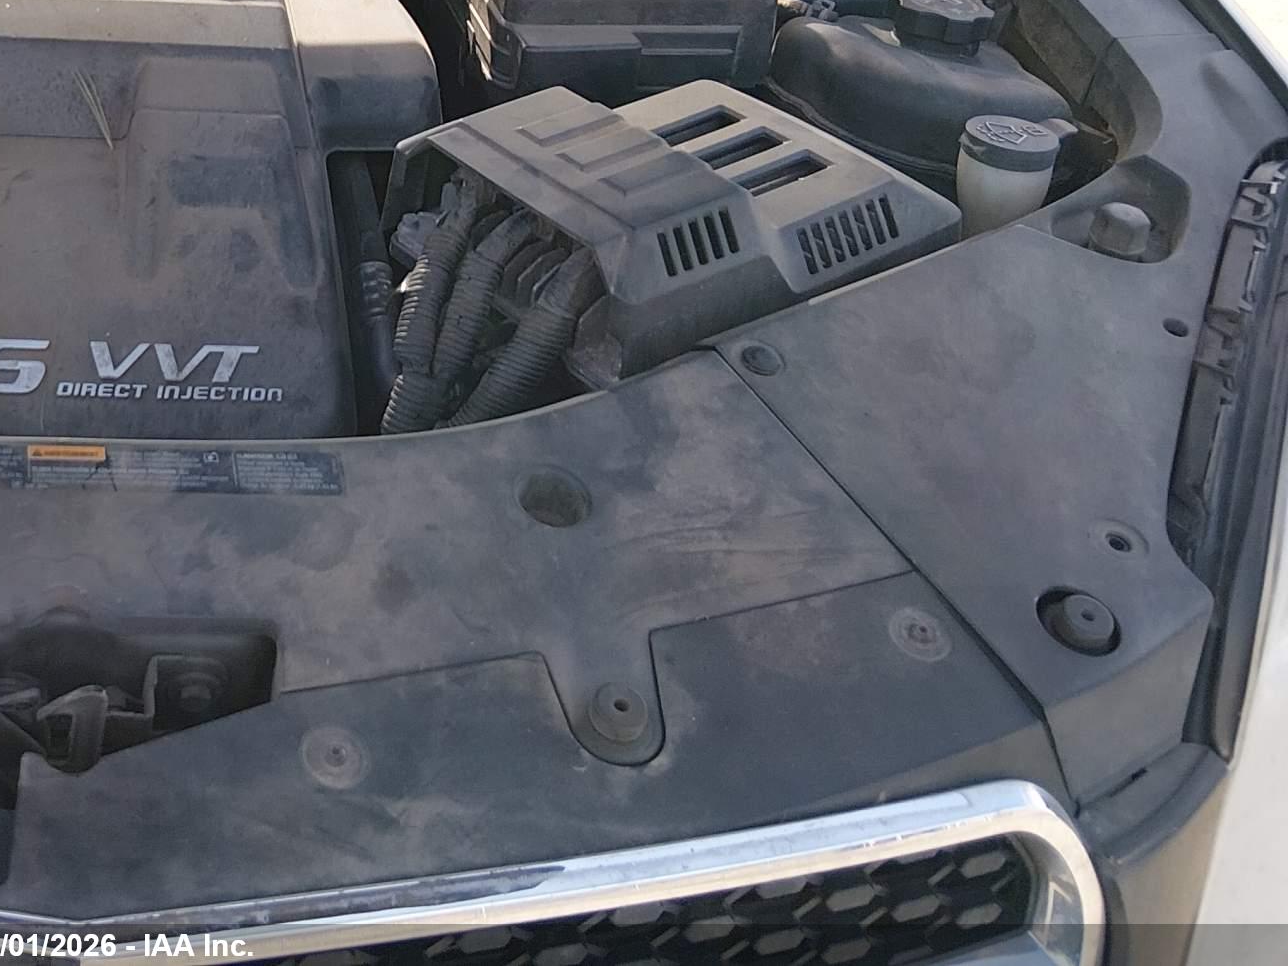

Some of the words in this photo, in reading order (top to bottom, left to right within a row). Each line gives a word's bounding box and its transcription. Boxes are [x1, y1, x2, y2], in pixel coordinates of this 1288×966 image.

[90, 340, 260, 383] VVT
[56, 381, 148, 399] DIRECT
[156, 384, 283, 402] INJECTION
